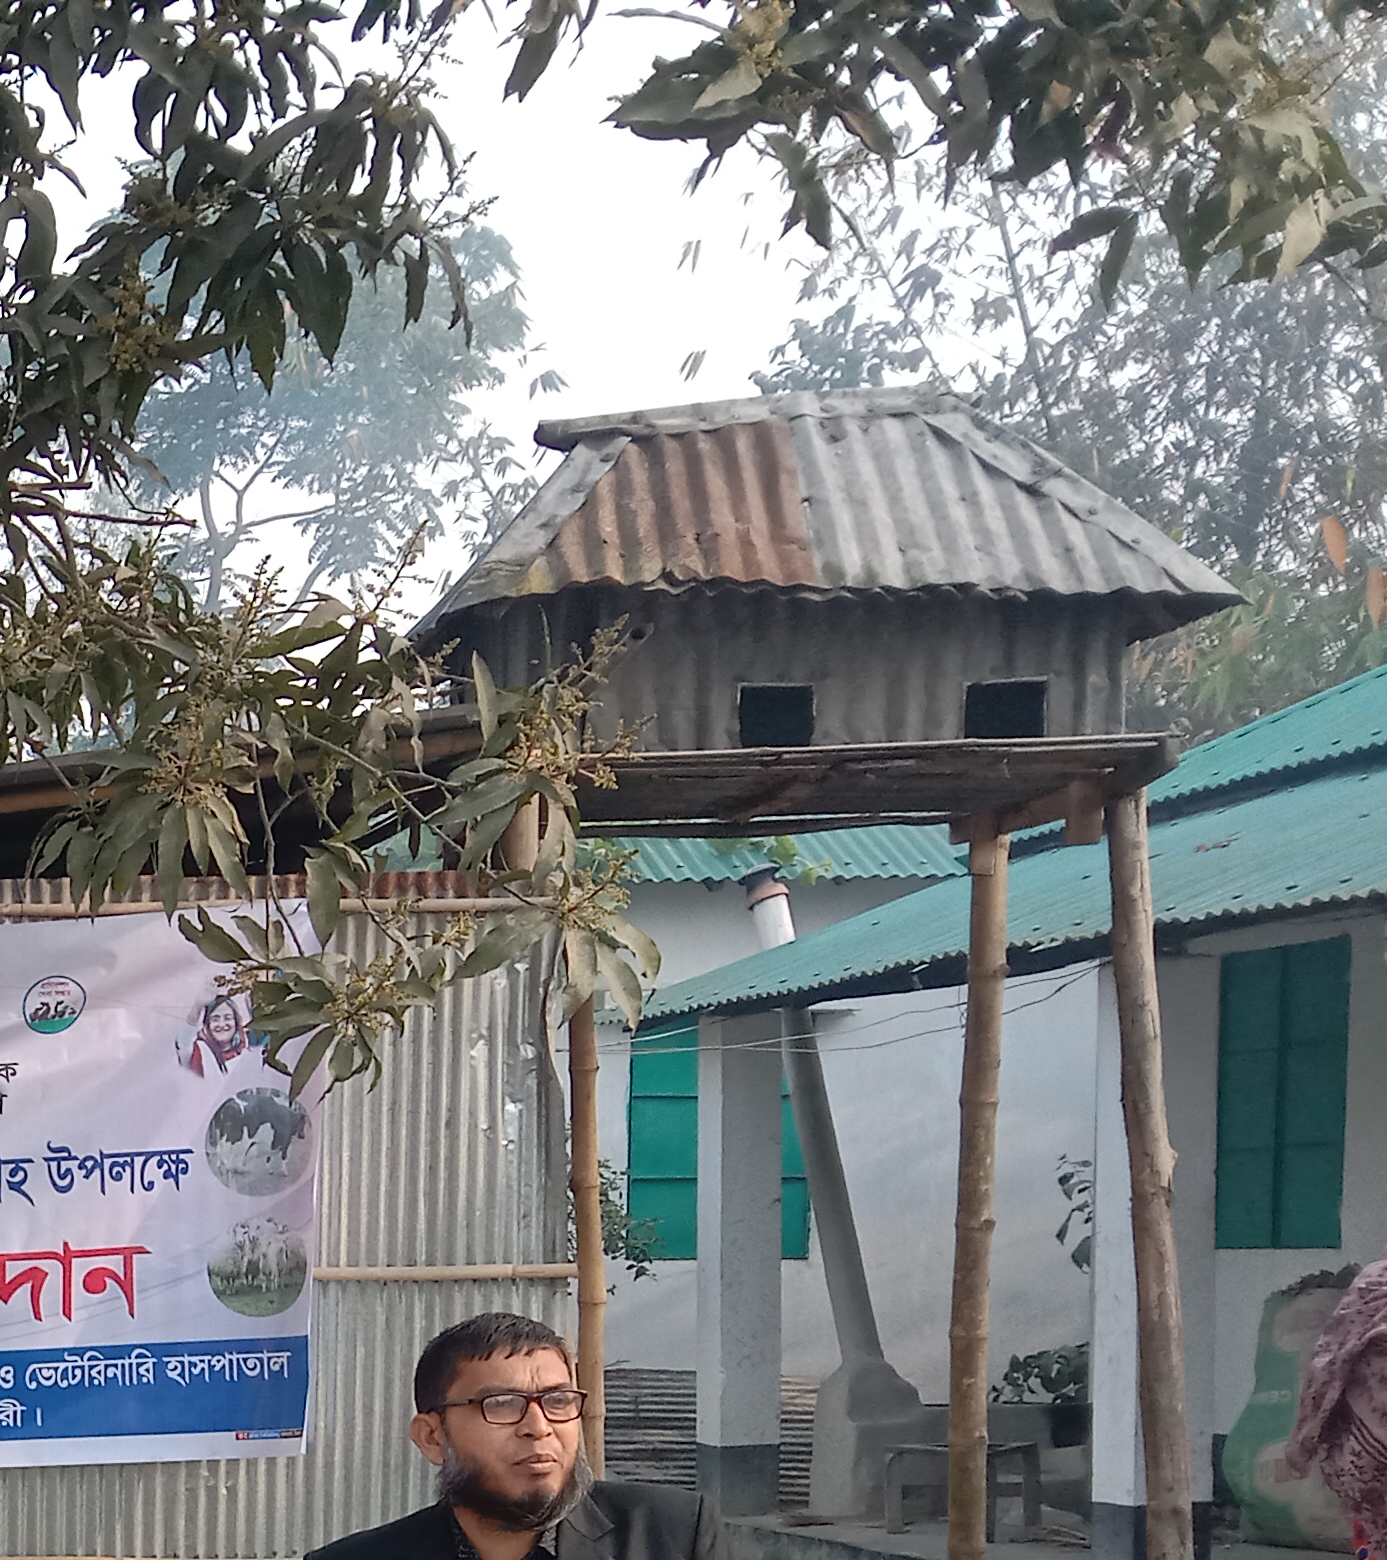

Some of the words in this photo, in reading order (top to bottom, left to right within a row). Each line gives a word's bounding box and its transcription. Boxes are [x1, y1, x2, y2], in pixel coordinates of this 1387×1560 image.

[43, 1140, 194, 1196] উপলক্ষে
[25, 1348, 157, 1390] ভেটেরিনারি
[162, 1350, 292, 1387] হাসপাতাল
